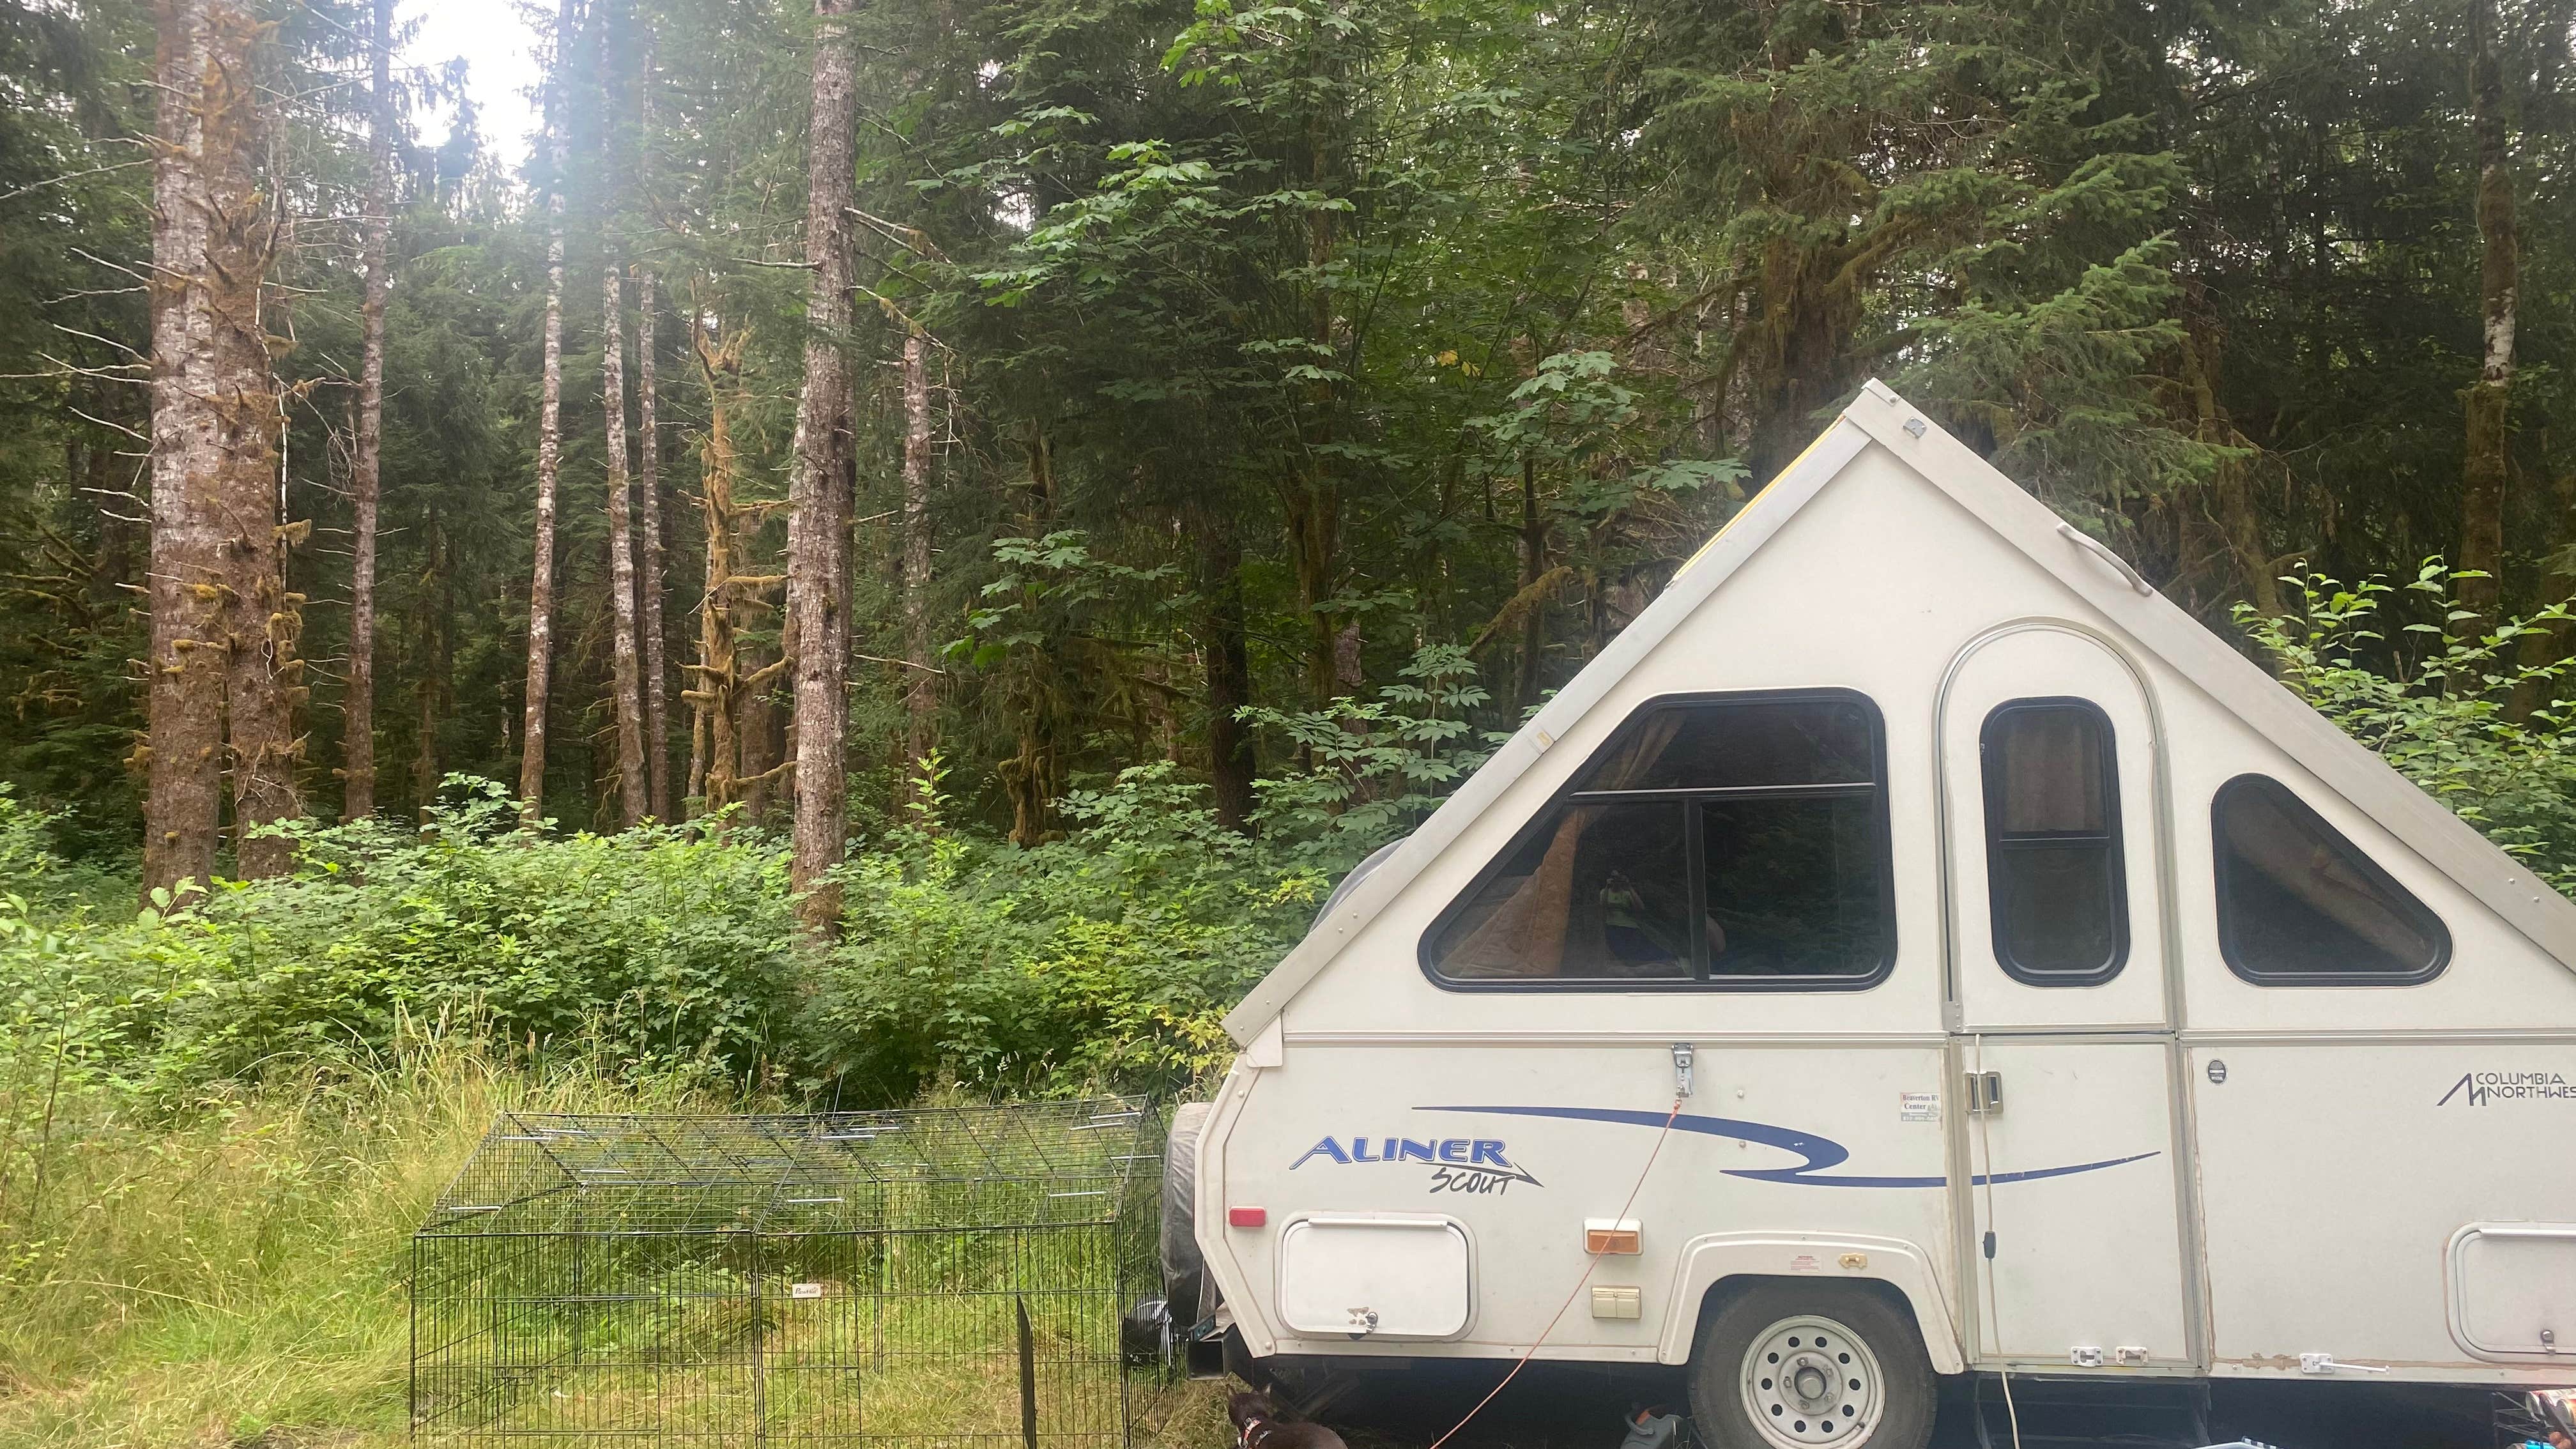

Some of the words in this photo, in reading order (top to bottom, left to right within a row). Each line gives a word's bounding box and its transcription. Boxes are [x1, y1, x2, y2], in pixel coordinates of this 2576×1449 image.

[2476, 1073, 2566, 1085] COLUMBIA
[1289, 1135, 1513, 1170] ALINER
[1429, 1167, 1517, 1195] SCOUT
